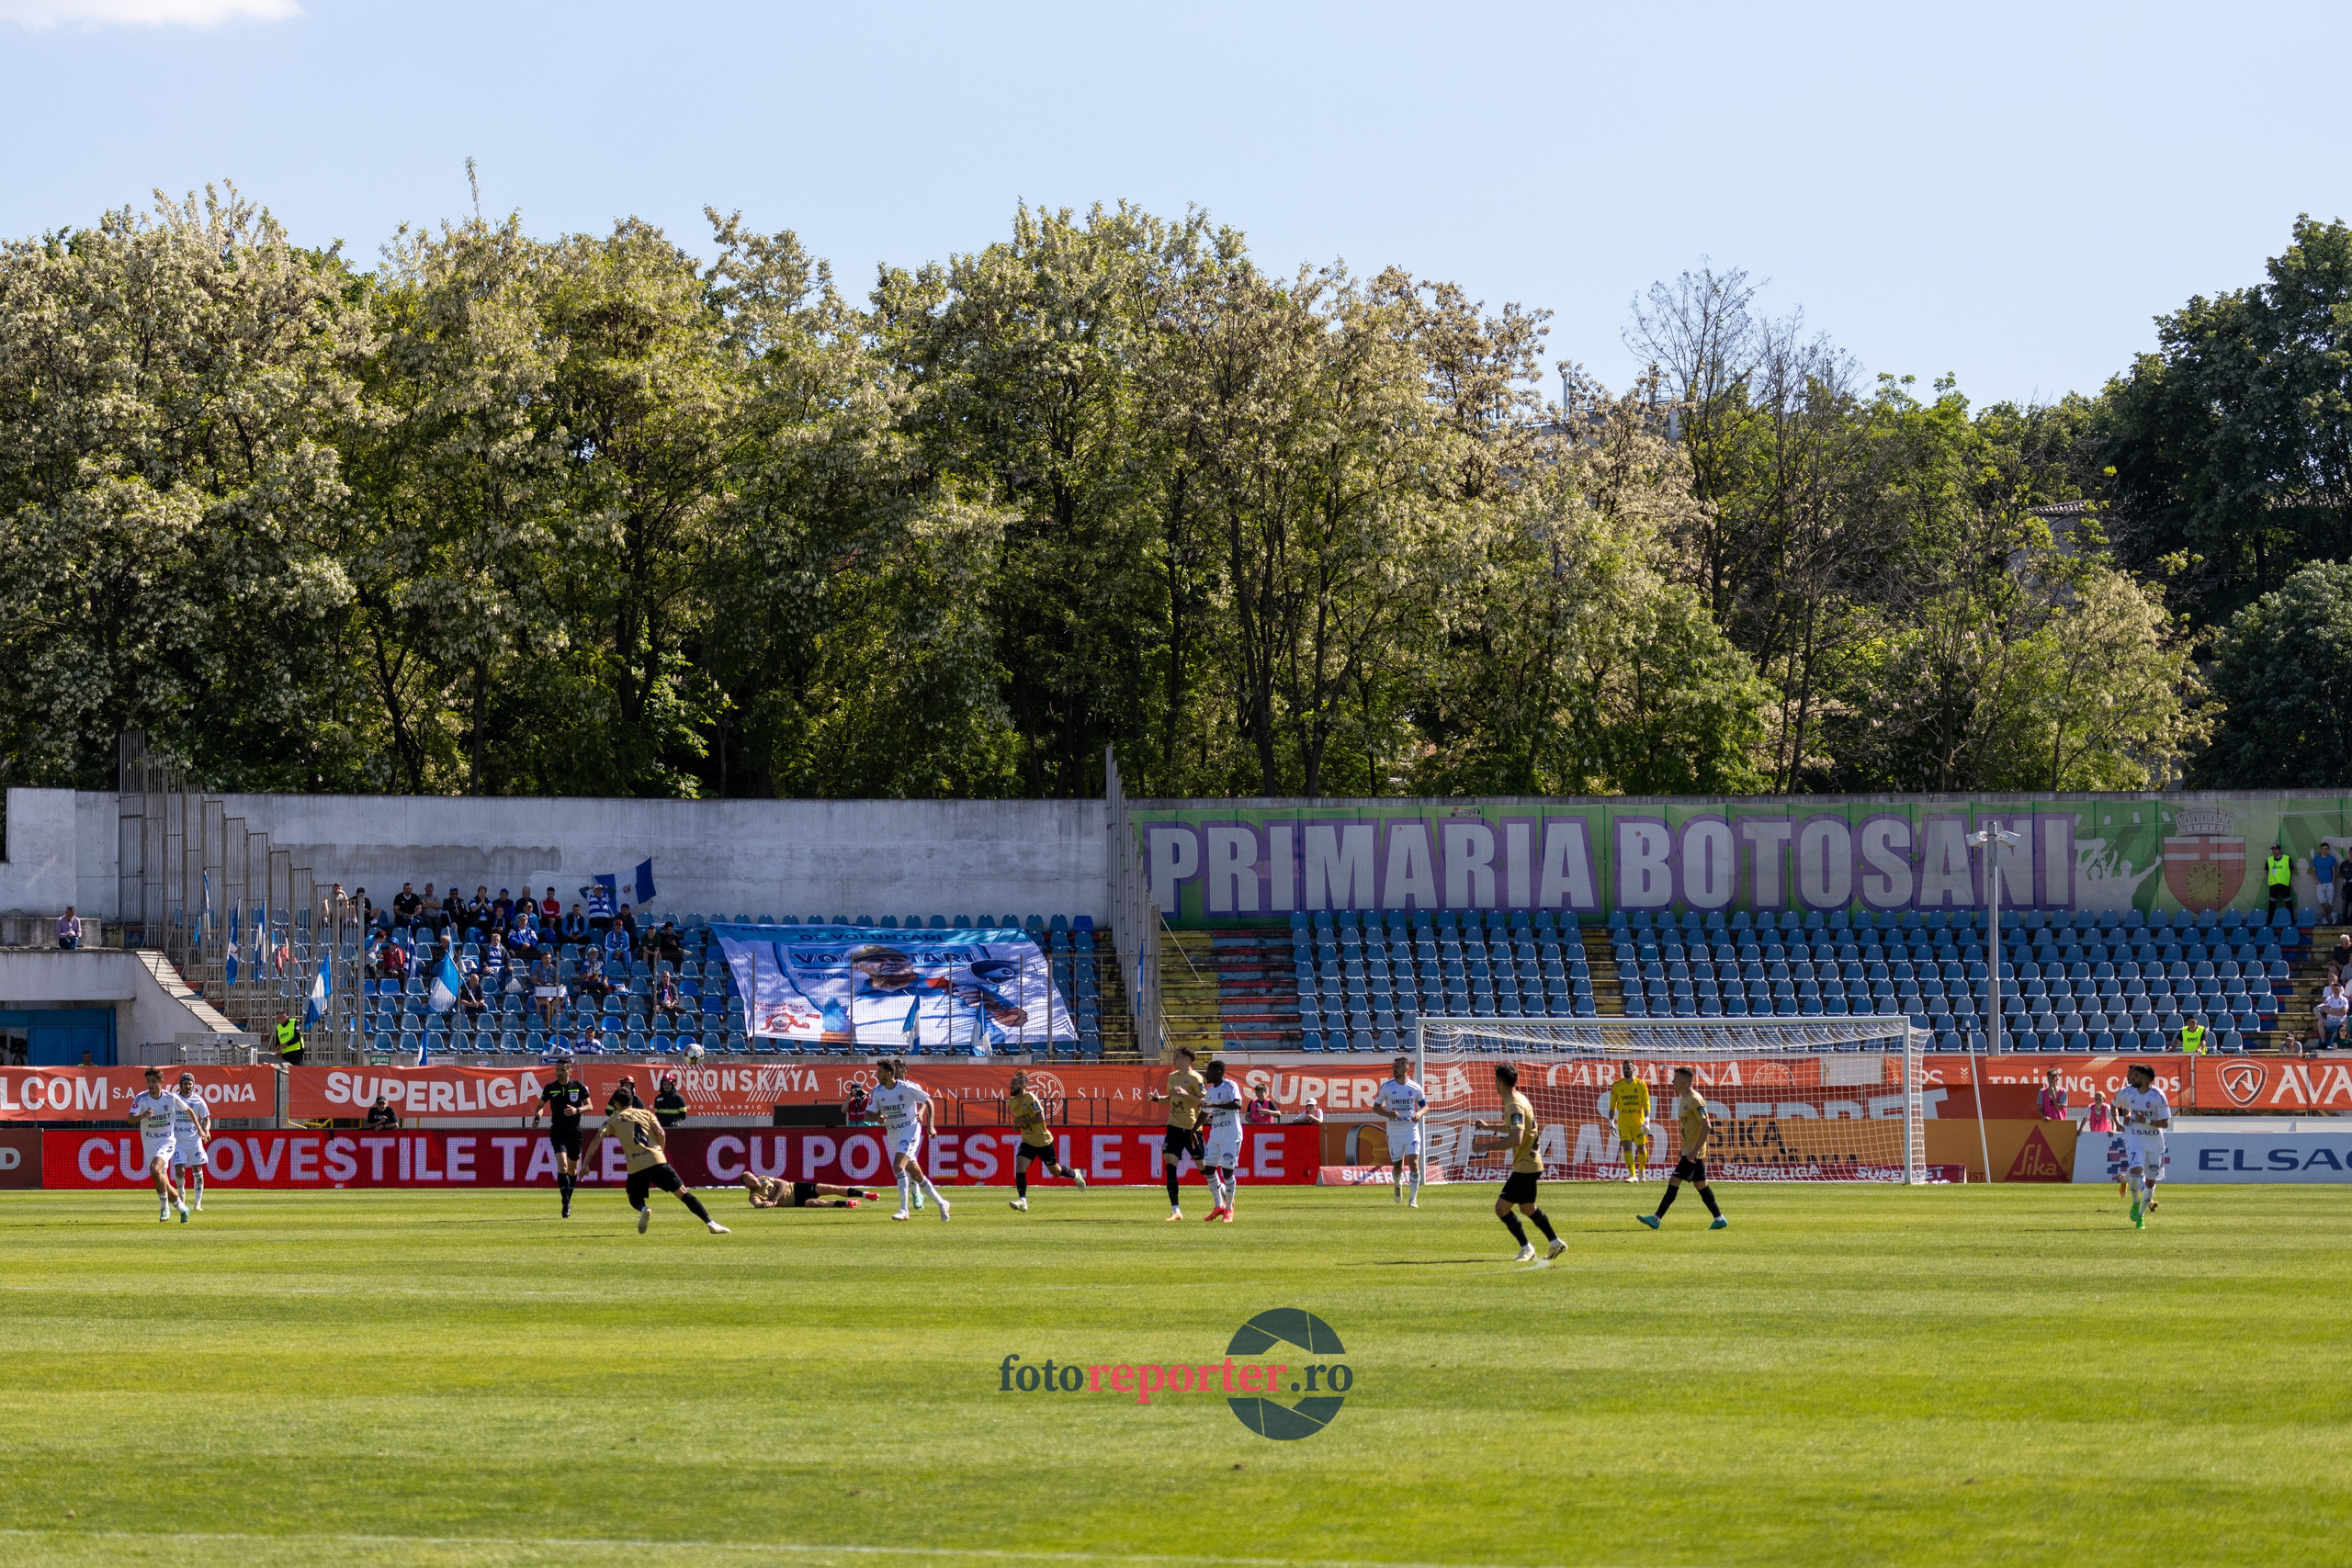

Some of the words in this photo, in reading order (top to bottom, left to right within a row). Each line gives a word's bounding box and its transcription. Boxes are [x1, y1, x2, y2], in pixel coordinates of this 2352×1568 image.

[1148, 823, 1594, 912] PRIMARIA
[1621, 818, 2068, 911] BOTOSANI
[799, 933, 825, 942] DE
[831, 932, 943, 942] VOLUNTARI
[324, 1071, 546, 1112] SUPERLIGA
[169, 1136, 478, 1189] OVEȘTILE
[707, 1134, 787, 1181] CU
[2013, 1144, 2058, 1176] Sika
